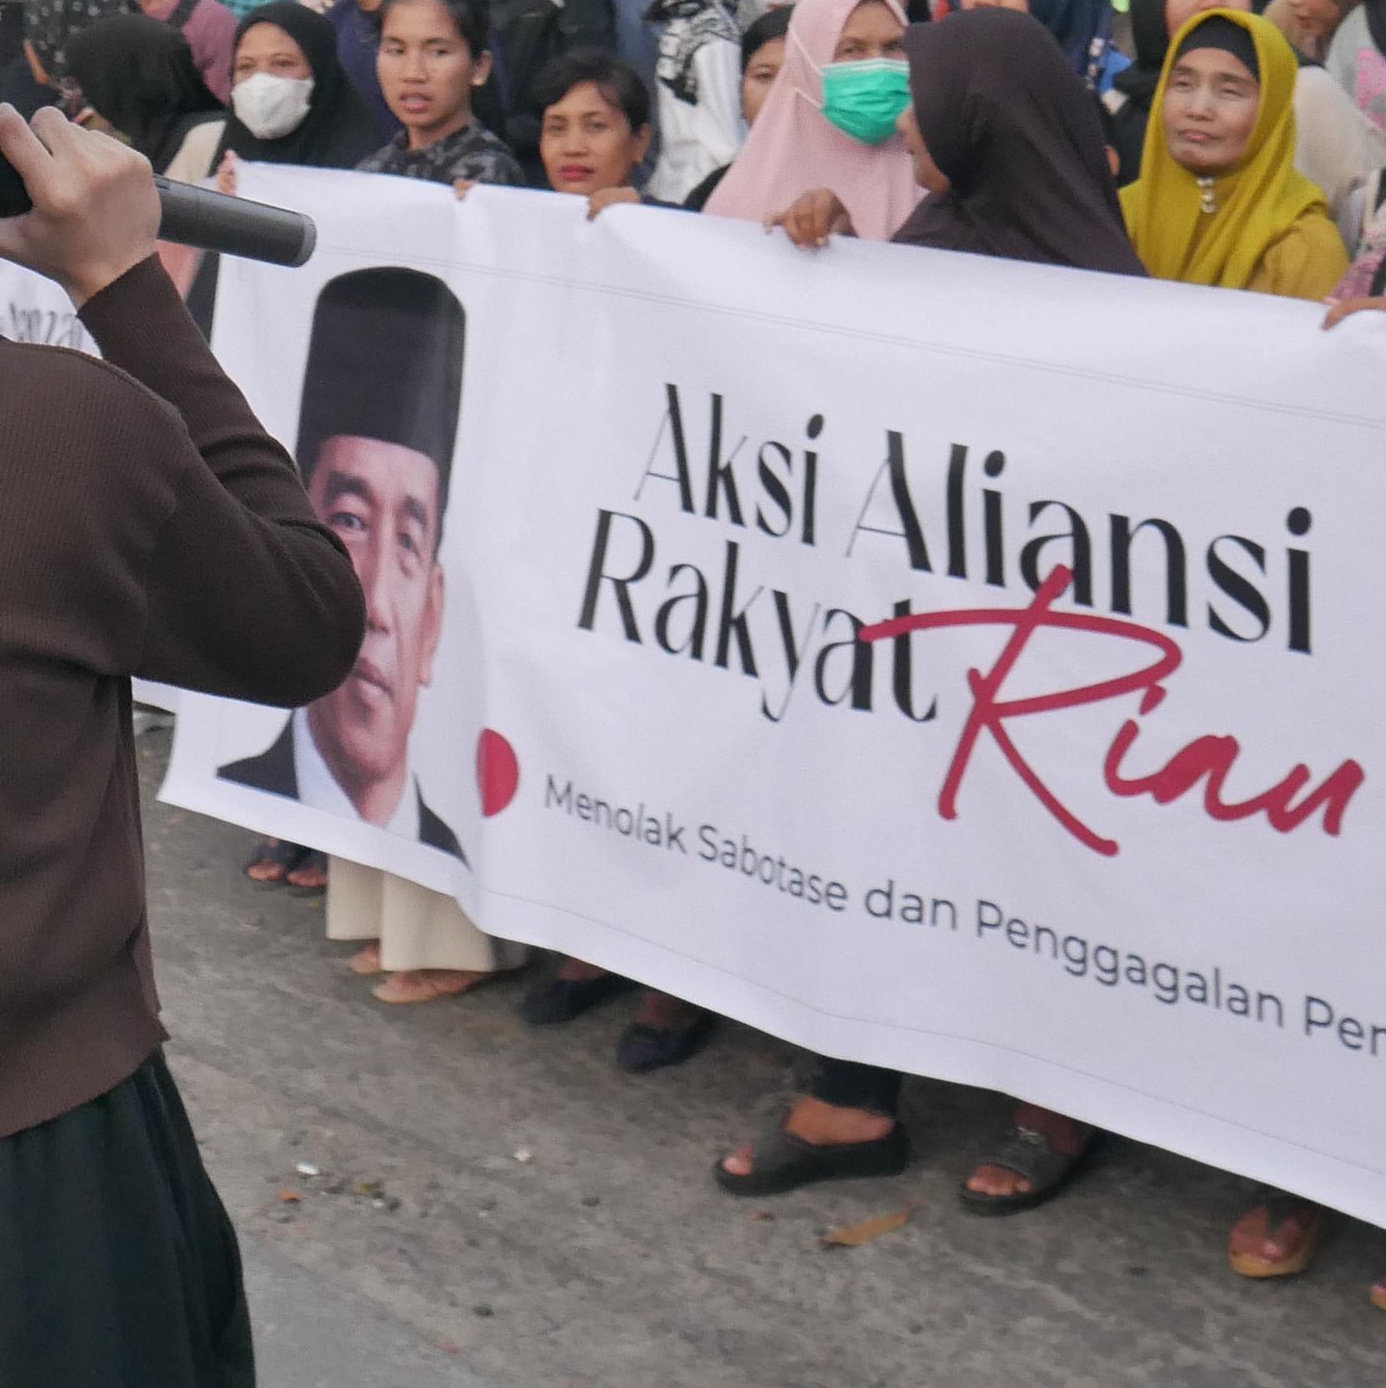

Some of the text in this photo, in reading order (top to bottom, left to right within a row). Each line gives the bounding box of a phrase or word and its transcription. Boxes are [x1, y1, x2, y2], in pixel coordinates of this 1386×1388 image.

[576, 507, 939, 723] Rakyat
[633, 381, 1313, 655] Aksi Aliansi
[858, 563, 1366, 858] Riau
[544, 773, 688, 856] Menolak
[697, 824, 849, 913] Sabotase
[863, 878, 959, 933] dan
[975, 898, 1286, 1028] Penggagalan
